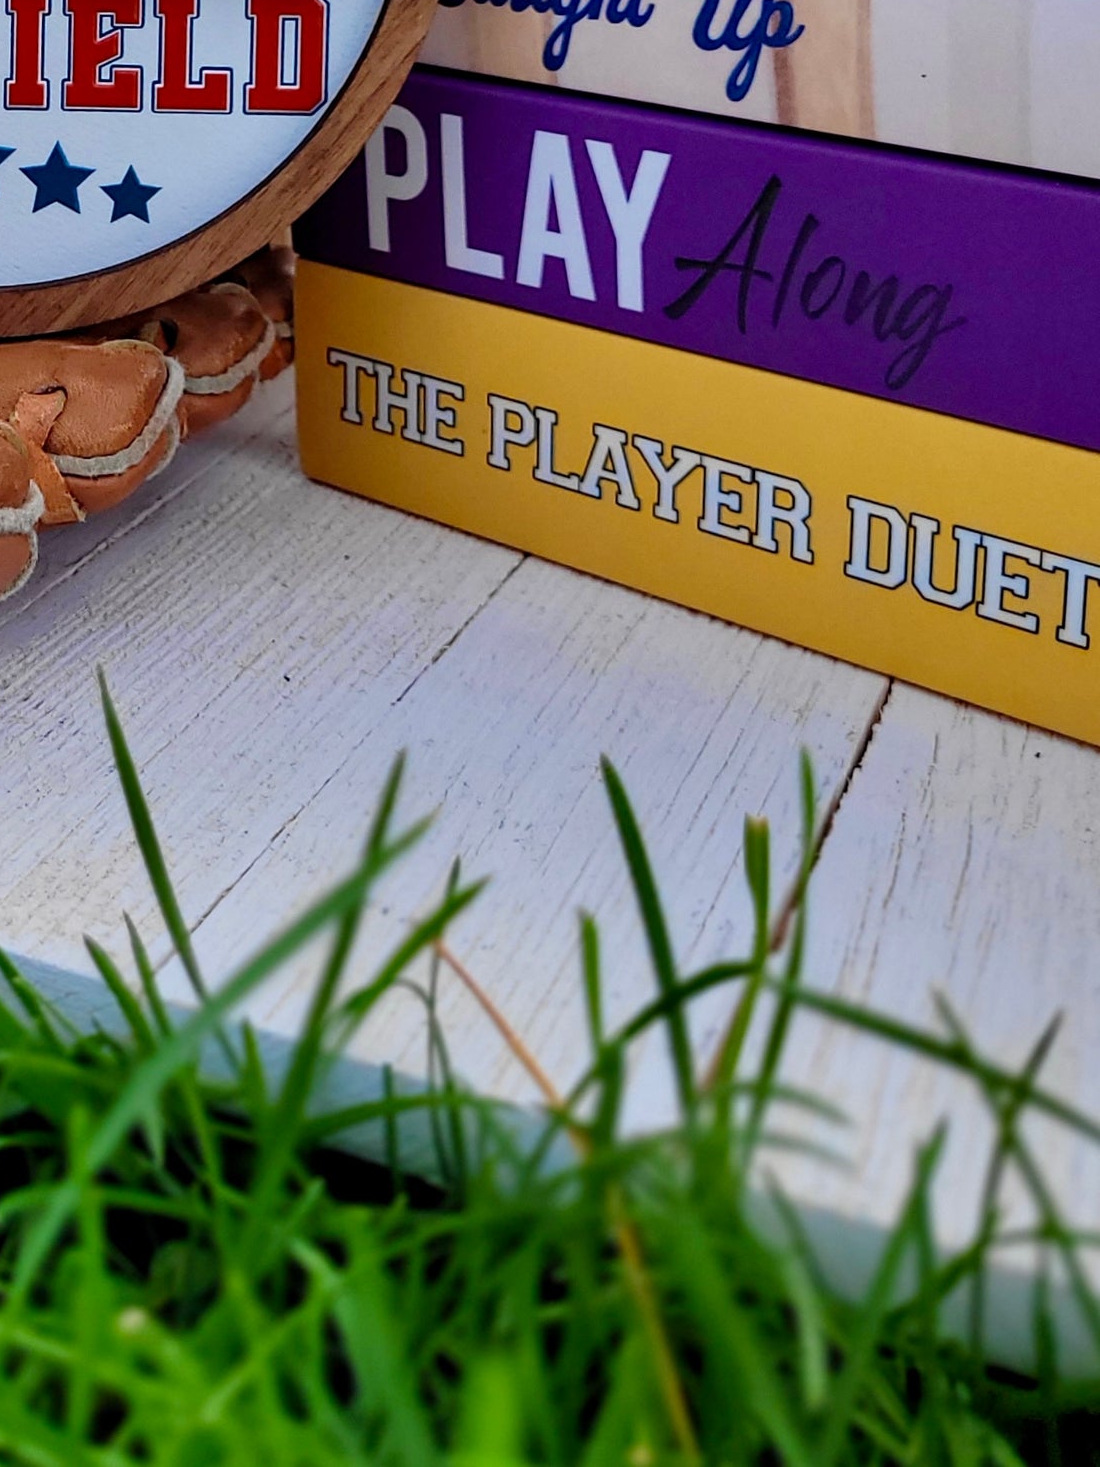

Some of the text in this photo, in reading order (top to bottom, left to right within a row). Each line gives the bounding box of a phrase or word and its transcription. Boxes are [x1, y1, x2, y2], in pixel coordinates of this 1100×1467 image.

[364, 102, 969, 391] PLAY Along
[326, 347, 1100, 650] THE PLAYER DUET
